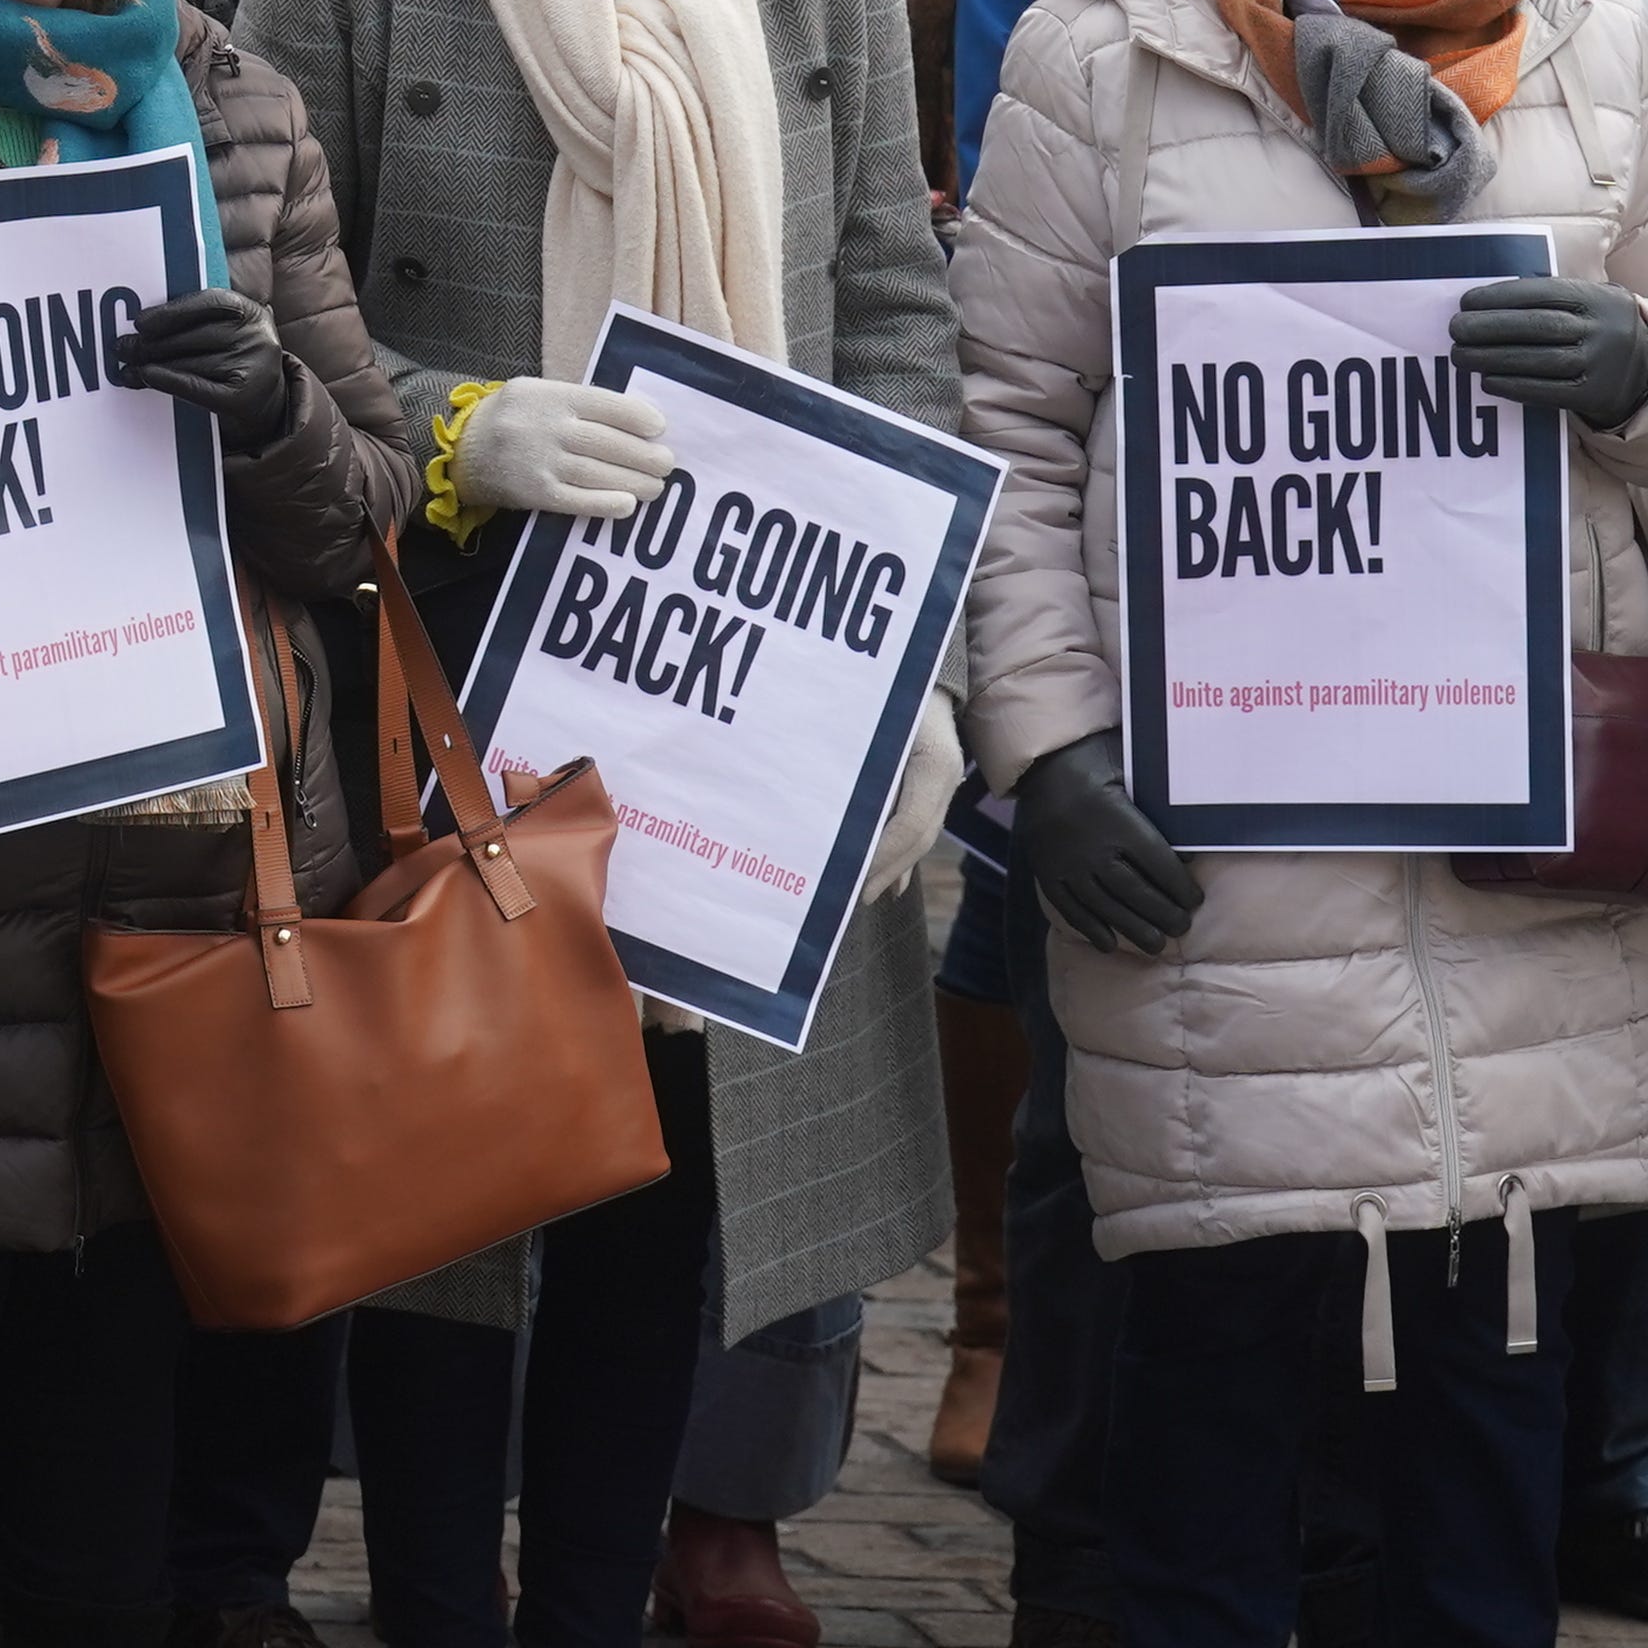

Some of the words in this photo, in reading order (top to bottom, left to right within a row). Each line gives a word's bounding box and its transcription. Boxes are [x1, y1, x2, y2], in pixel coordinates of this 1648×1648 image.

[1172, 362, 1265, 464] NO
[1288, 356, 1499, 460] GOING
[692, 492, 905, 658] GOING
[1175, 472, 1383, 579] BACK!
[11, 630, 118, 678] paramilitary
[123, 610, 196, 646] violence
[540, 556, 765, 724] BACK!
[1172, 682, 1224, 709] Unite
[1230, 682, 1303, 714] against
[1309, 680, 1428, 712] paramilitary
[1435, 679, 1516, 705] violence
[731, 850, 806, 896] violence
